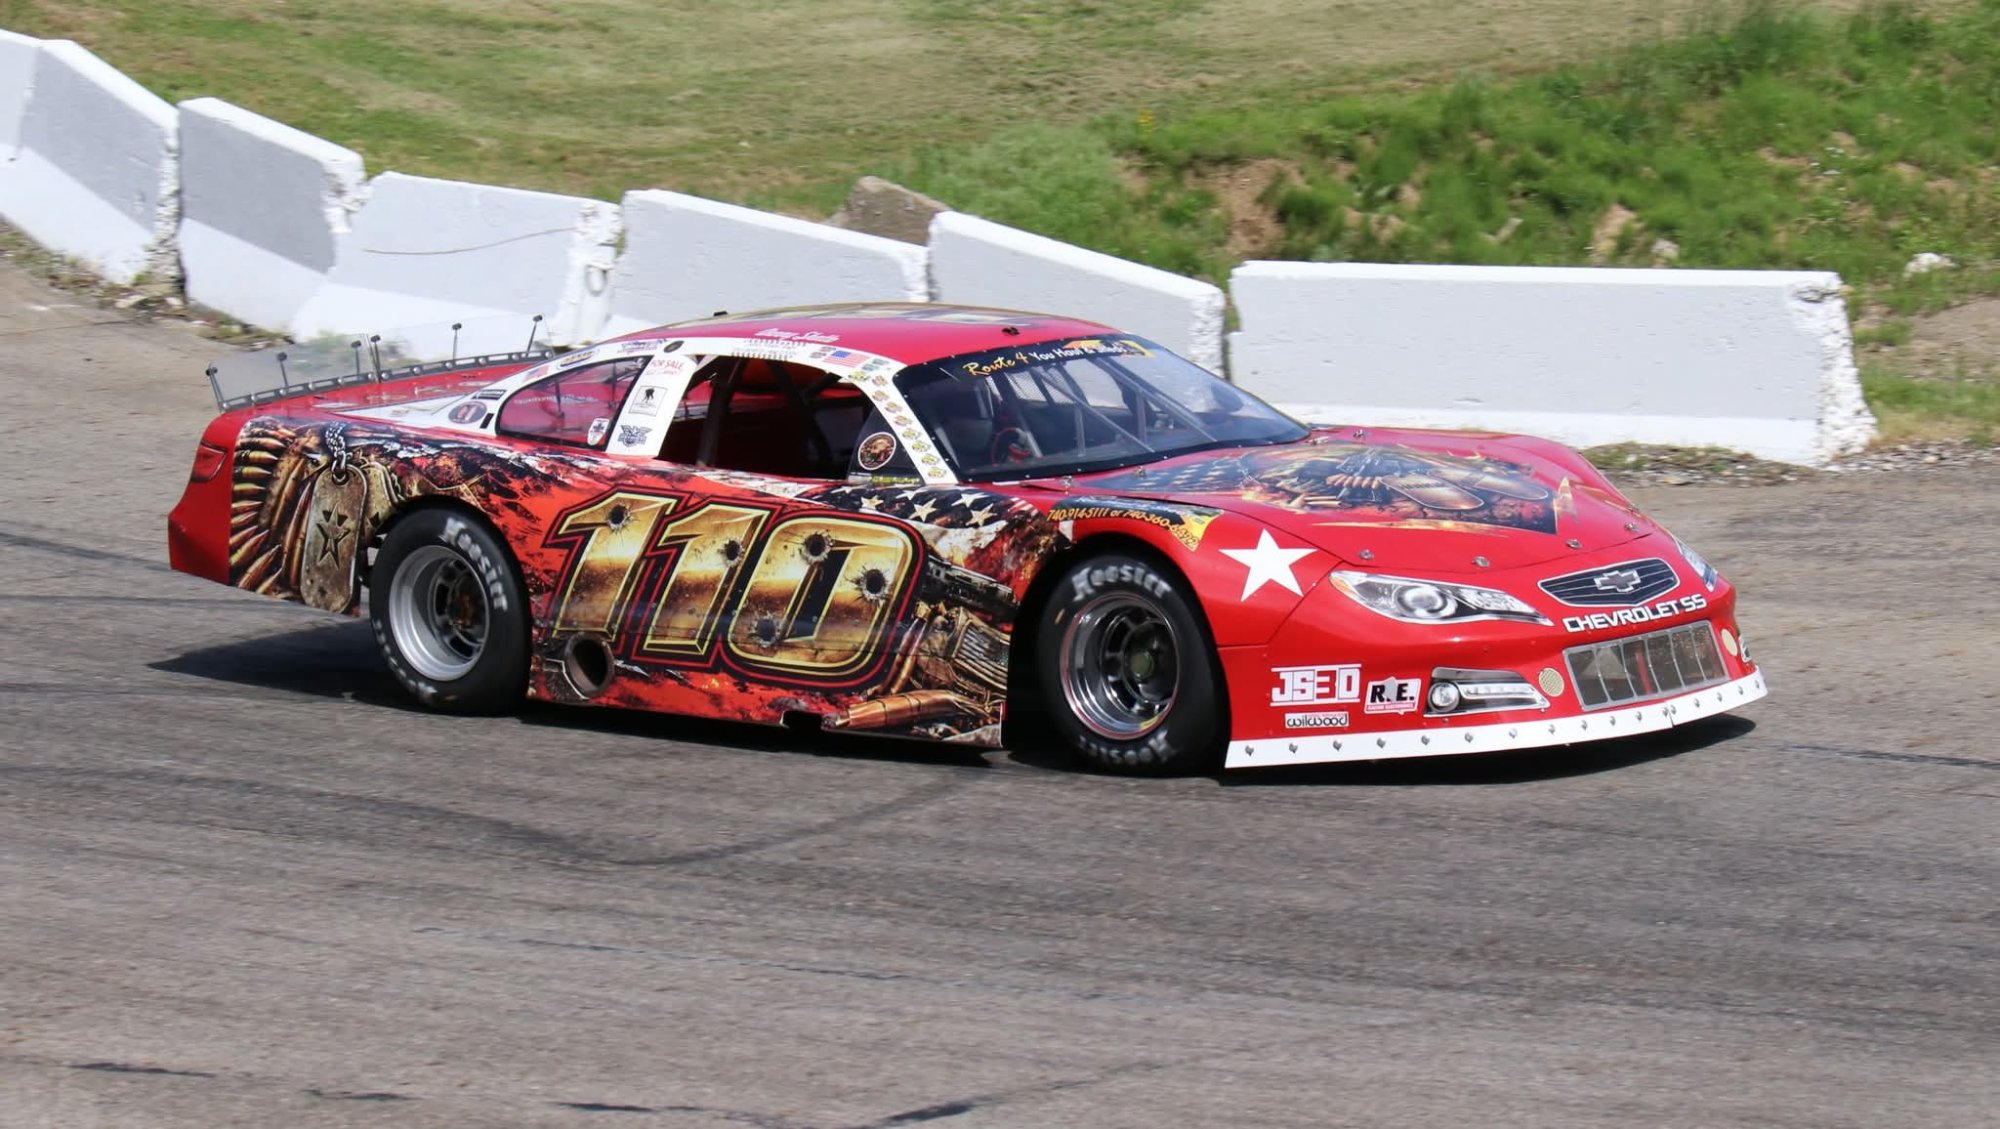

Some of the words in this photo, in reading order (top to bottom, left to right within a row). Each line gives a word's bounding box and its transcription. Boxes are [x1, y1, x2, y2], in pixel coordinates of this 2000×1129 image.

[963, 356, 1015, 376] Route
[1015, 352, 1029, 364] 4
[1028, 351, 1055, 361] You
[549, 489, 917, 682] 110
[1071, 562, 1171, 602] Hoosier
[1562, 602, 1680, 633] CHEVROLET
[1679, 594, 1707, 613] SS
[1287, 713, 1348, 727] wilwood
